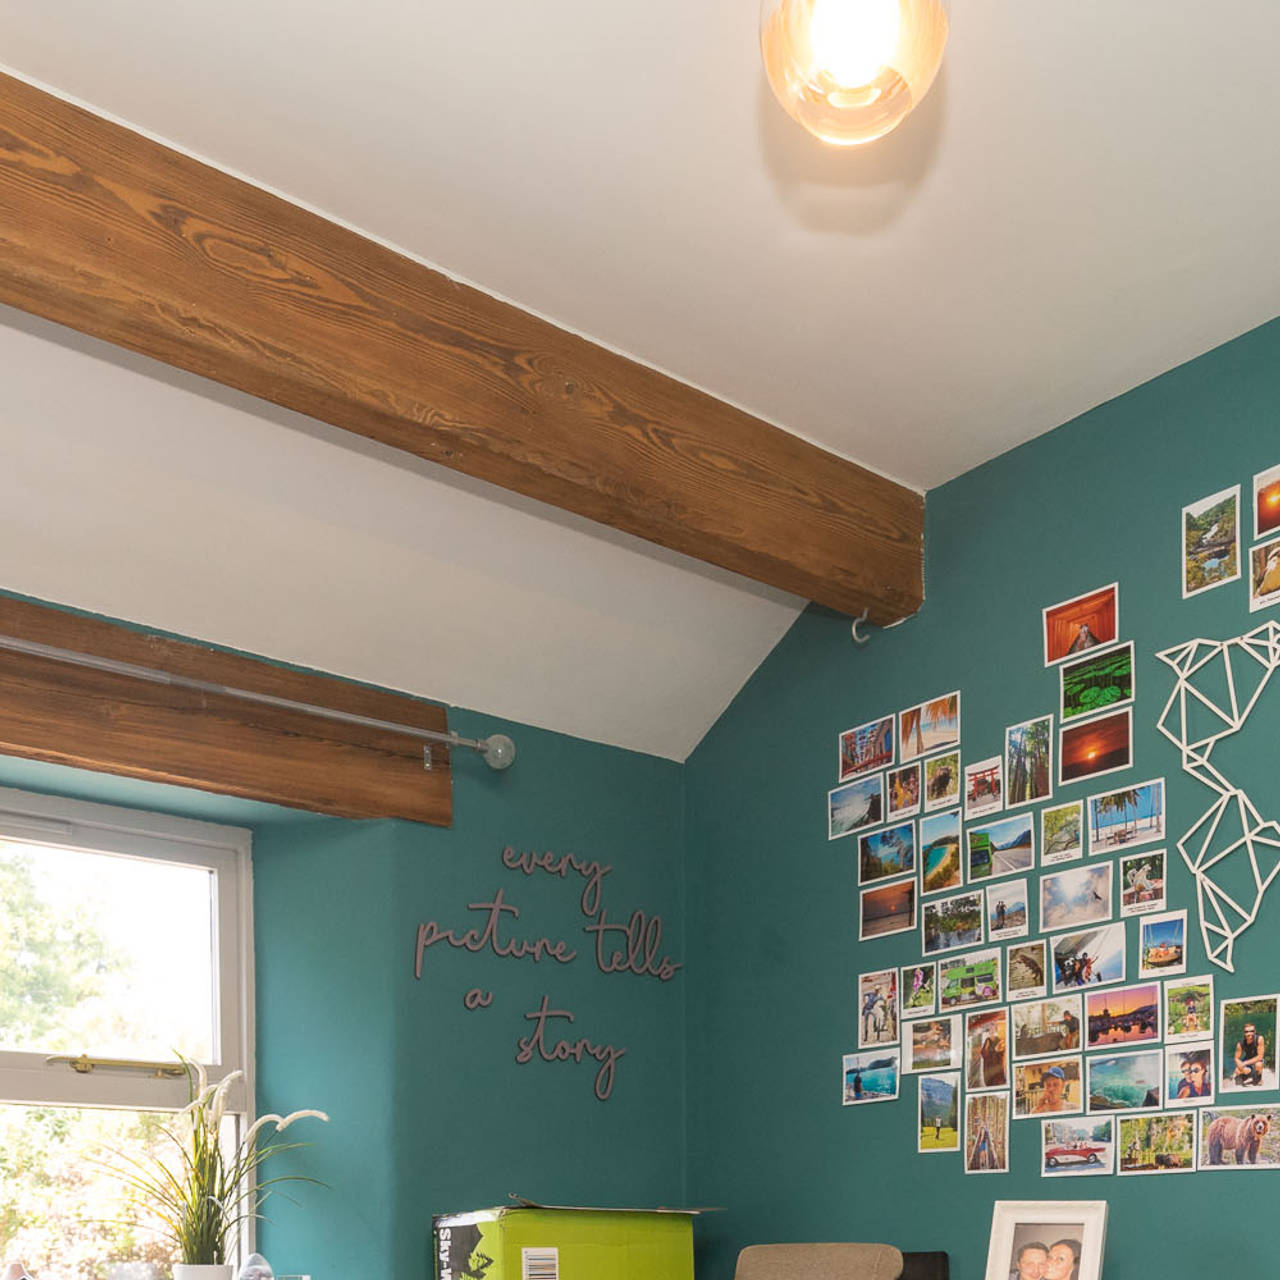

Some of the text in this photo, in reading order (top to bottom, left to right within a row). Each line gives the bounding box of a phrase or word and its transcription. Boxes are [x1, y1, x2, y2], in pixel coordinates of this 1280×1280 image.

[503, 846, 612, 916] every
[415, 889, 682, 980] picture tells
[464, 988, 493, 1009] a
[516, 996, 626, 1100] story
